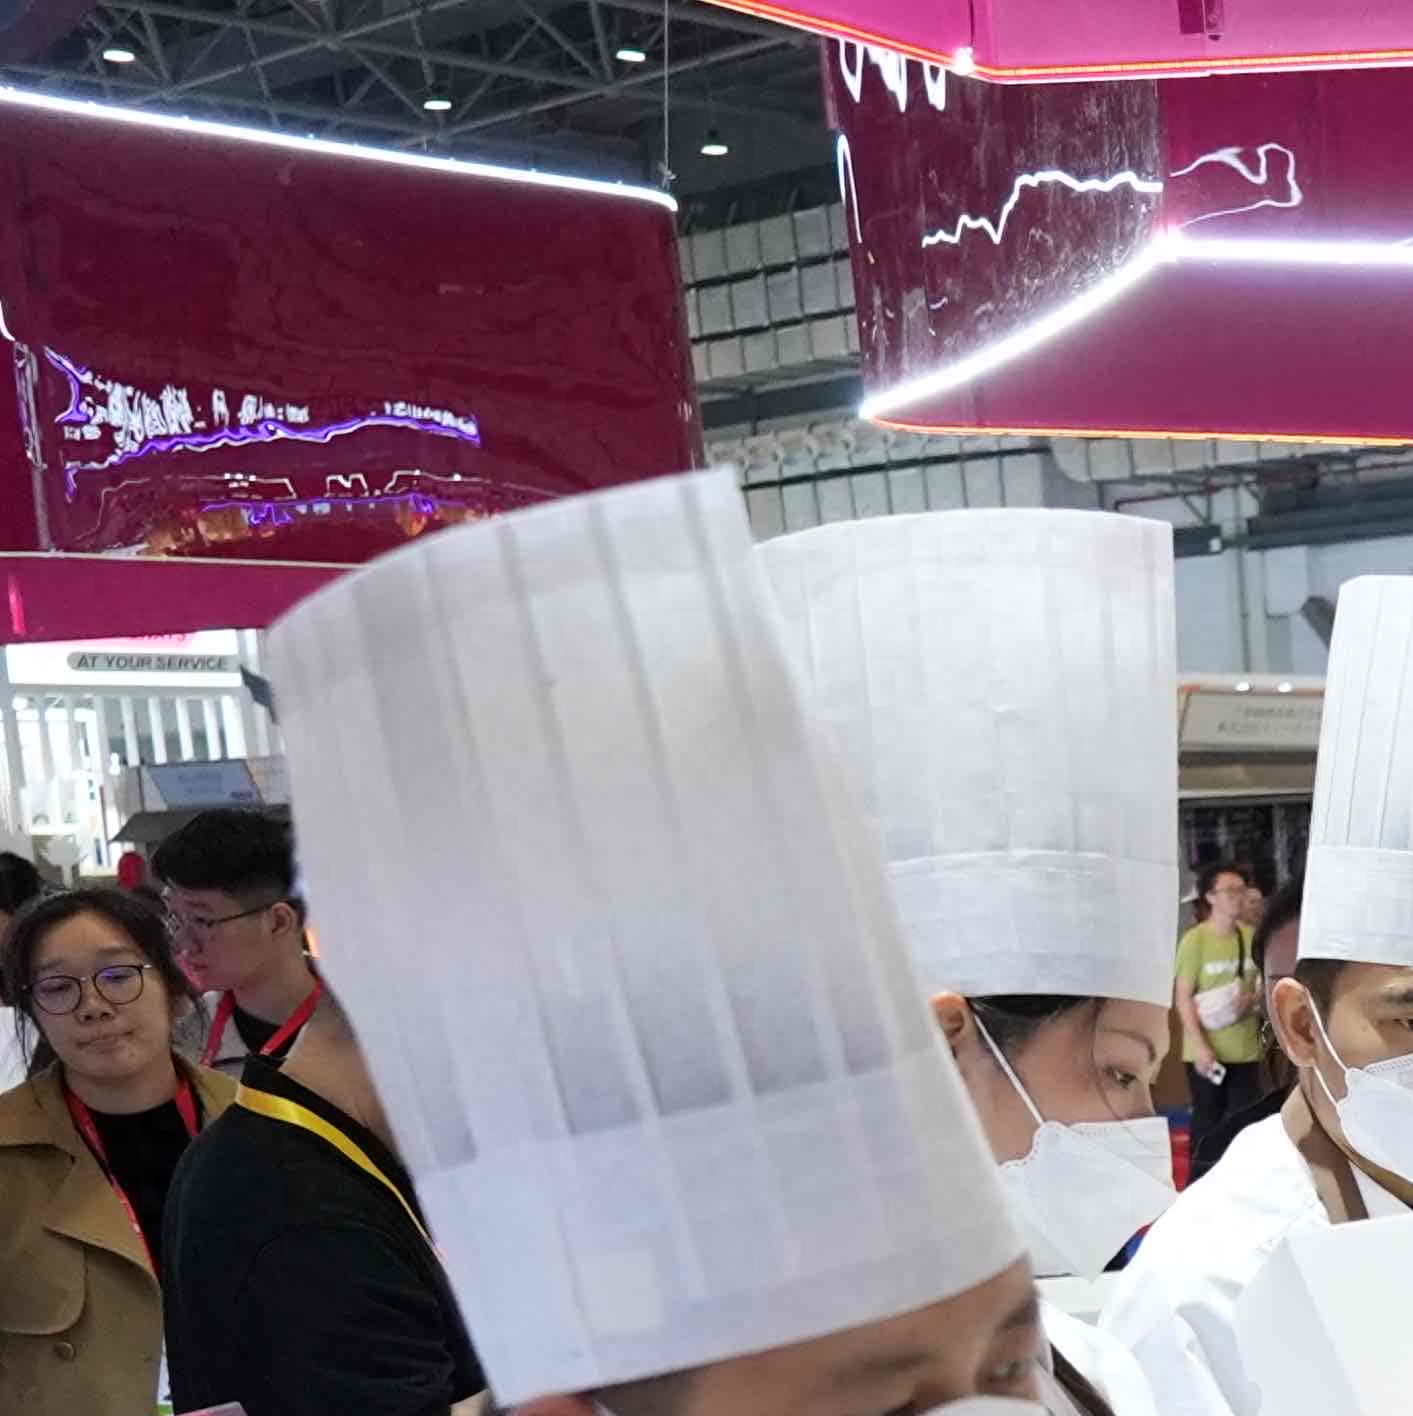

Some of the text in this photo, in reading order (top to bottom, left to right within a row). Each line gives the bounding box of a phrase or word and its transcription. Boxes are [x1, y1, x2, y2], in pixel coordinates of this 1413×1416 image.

[78, 655, 229, 671] AT YOUR SERVICE
